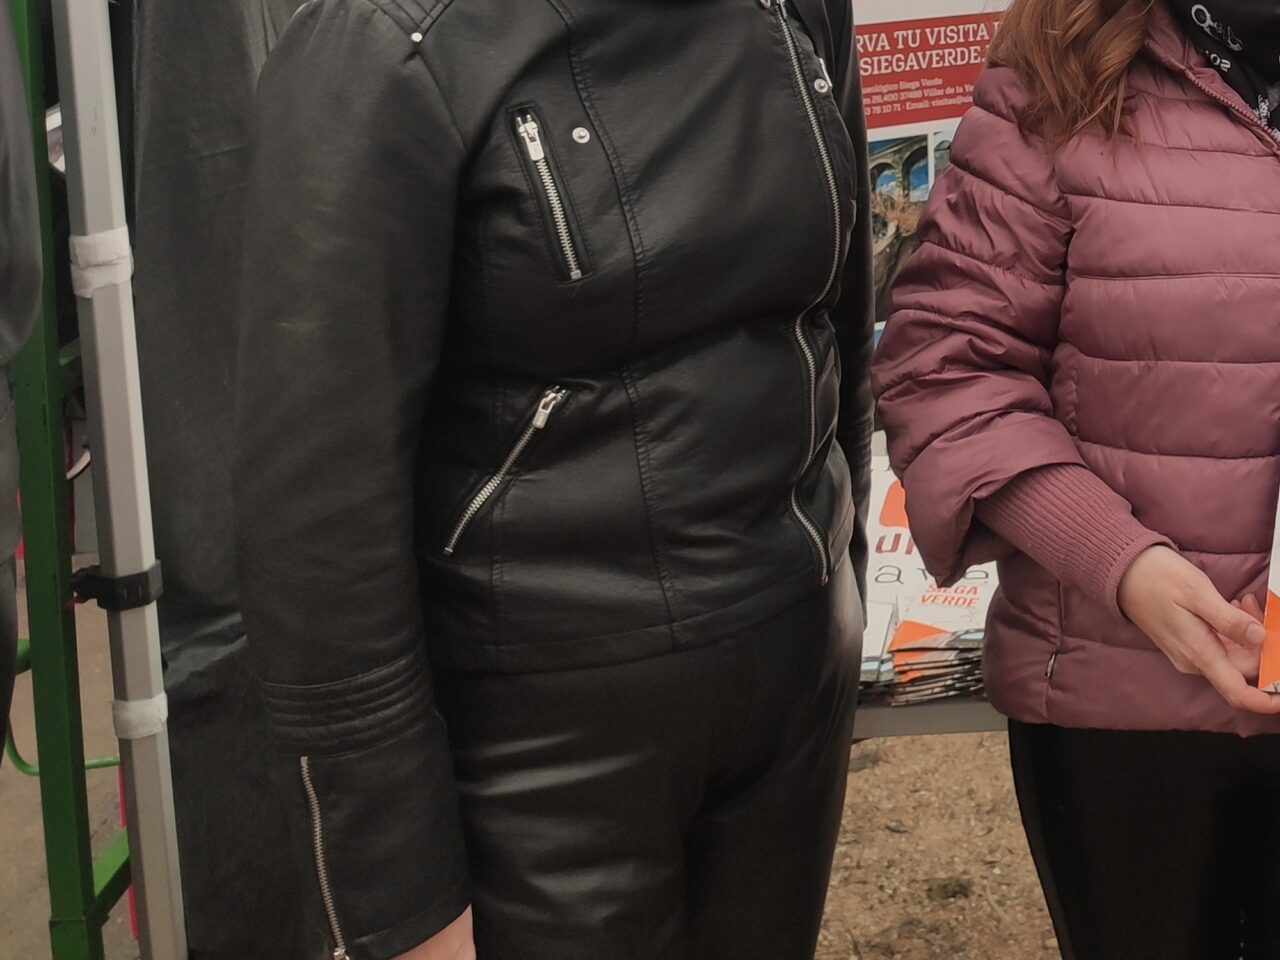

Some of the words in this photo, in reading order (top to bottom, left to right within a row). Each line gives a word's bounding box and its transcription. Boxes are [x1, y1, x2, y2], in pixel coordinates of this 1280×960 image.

[893, 29, 921, 49] TU
[925, 23, 990, 46] VISITA
[859, 45, 988, 76] SIEGAVERDE.
[921, 594, 979, 608] VERDE
